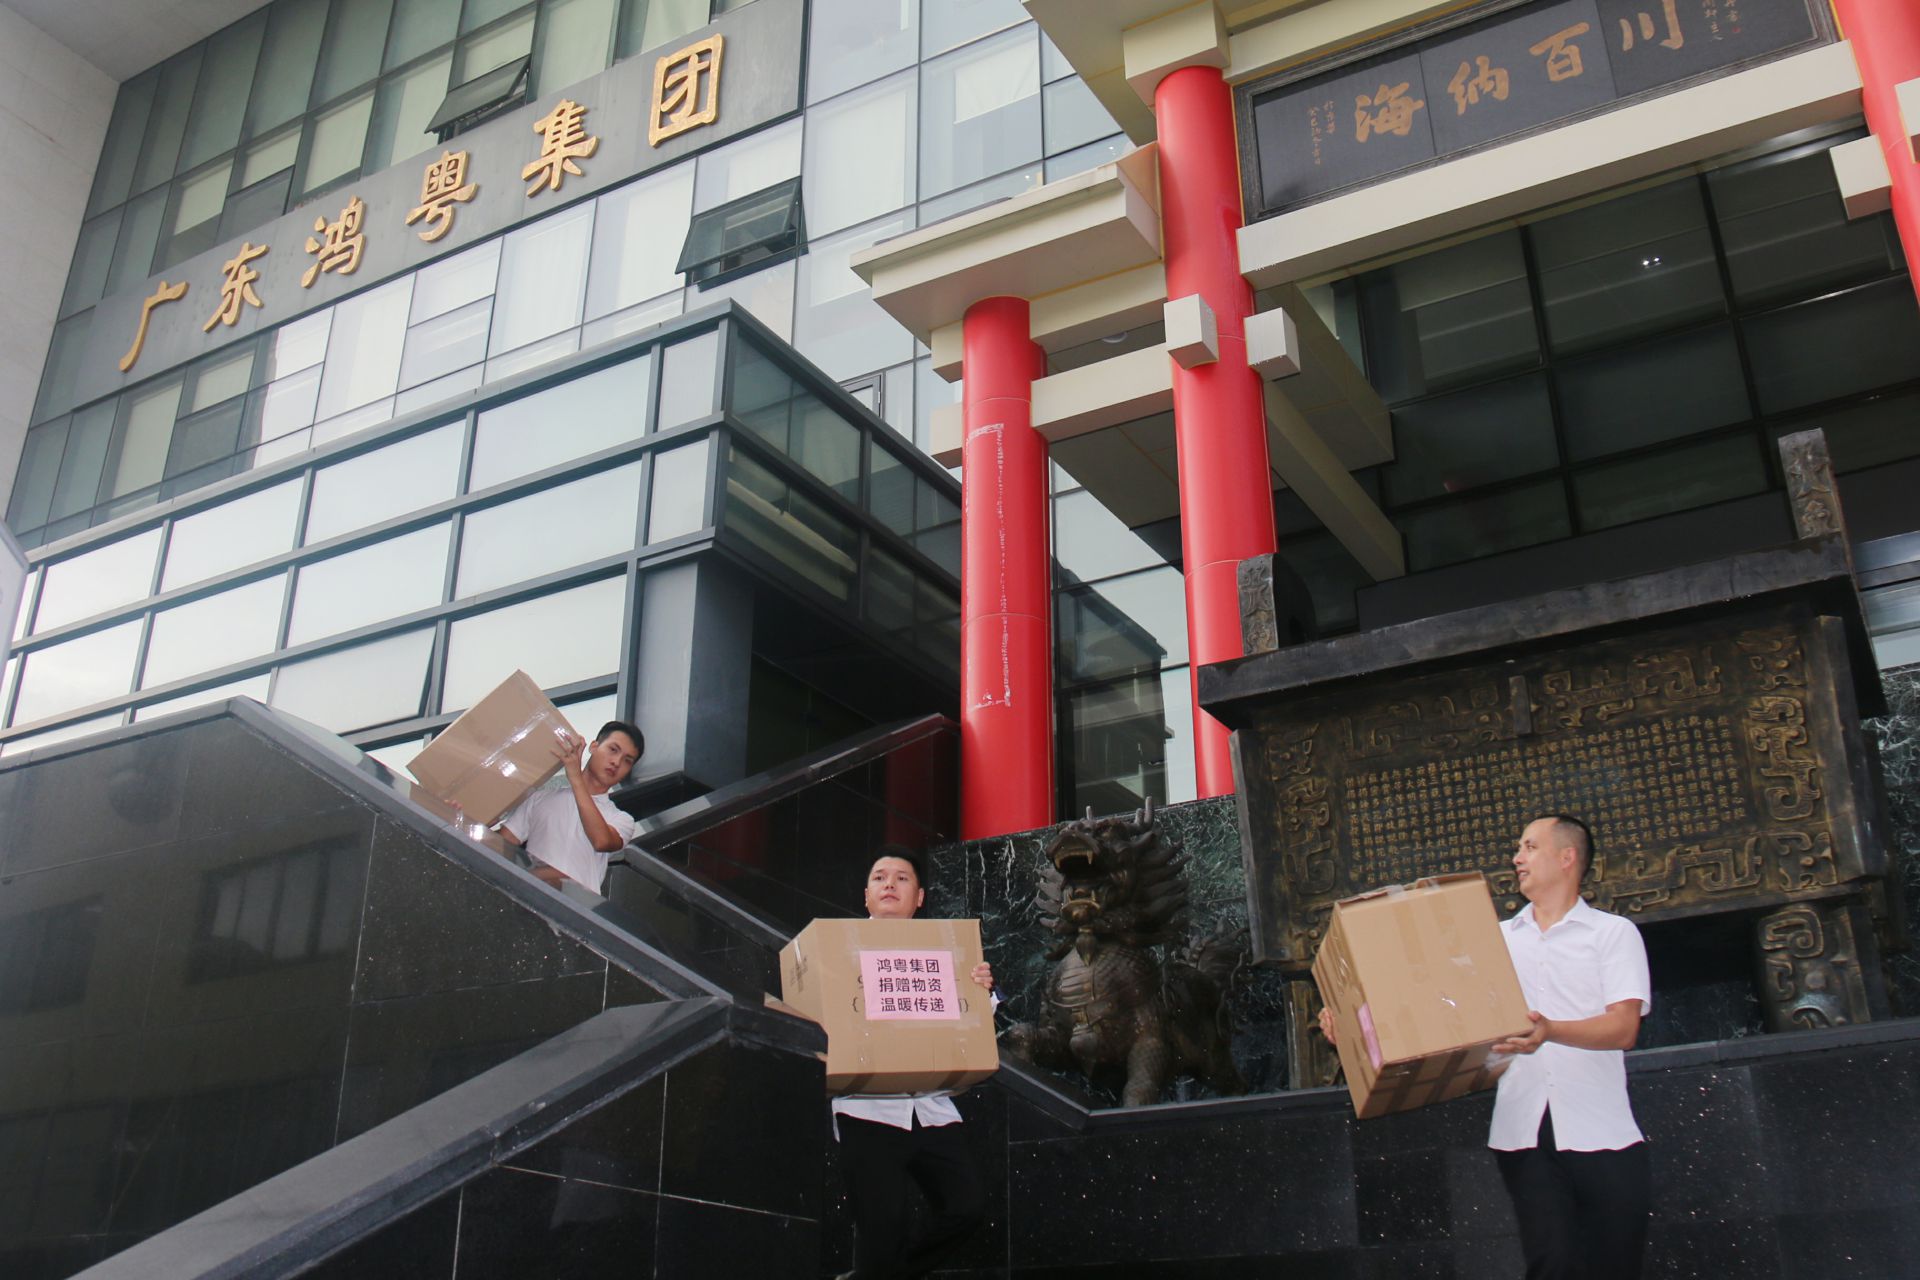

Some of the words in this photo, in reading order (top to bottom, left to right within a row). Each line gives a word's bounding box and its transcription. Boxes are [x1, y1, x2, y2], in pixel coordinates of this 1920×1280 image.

[1354, 0, 1686, 144] 海纳百川
[119, 32, 725, 373] 广东鸿粤集团
[877, 957, 940, 973] 鸿粤集团
[879, 977, 942, 993] 捐赠物资
[880, 996, 945, 1012] 温暖传递
